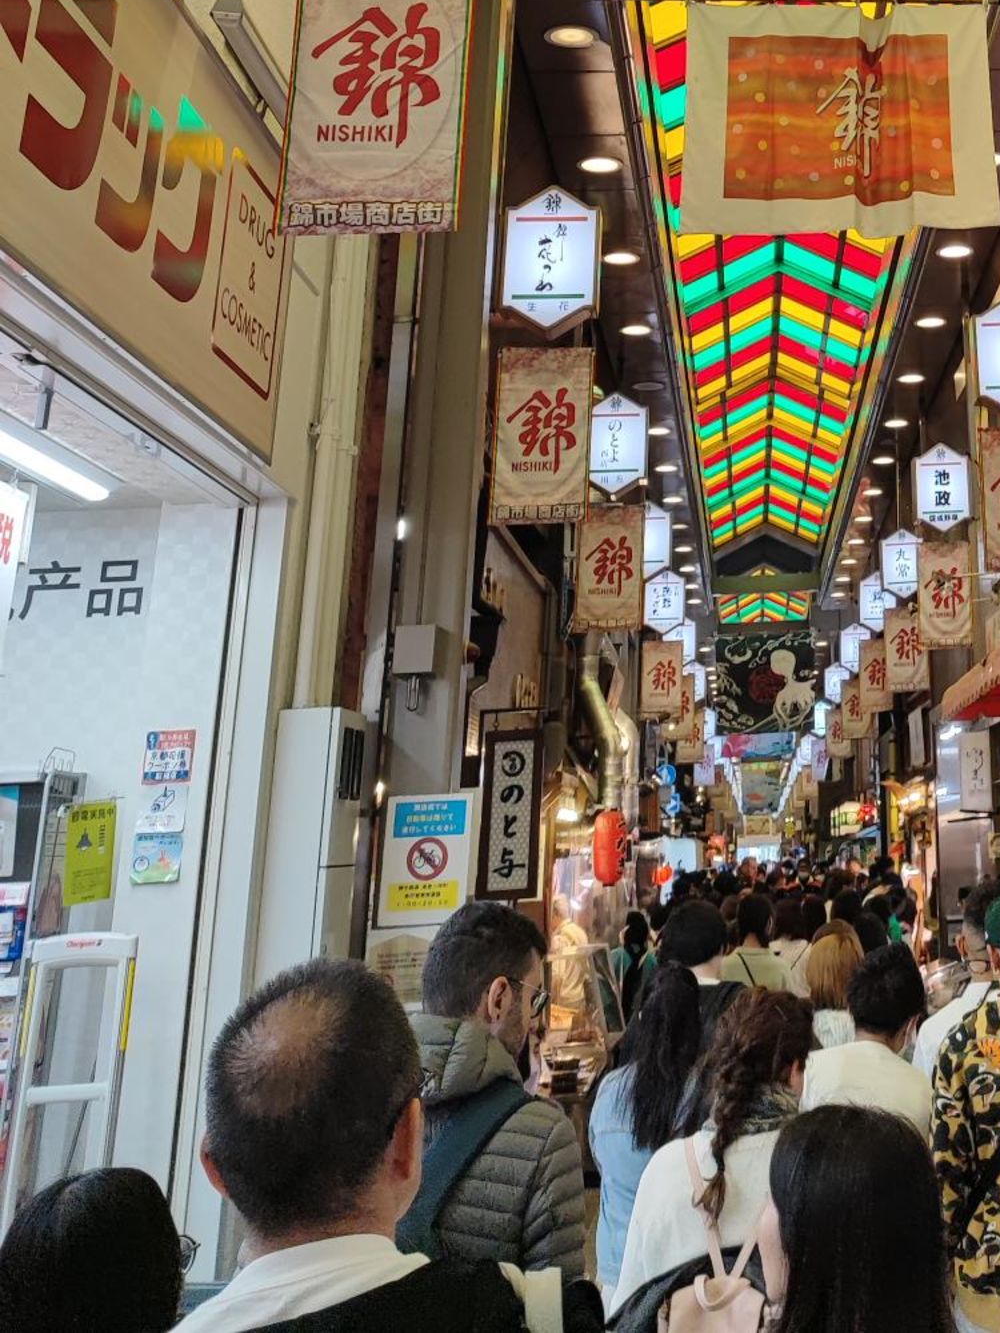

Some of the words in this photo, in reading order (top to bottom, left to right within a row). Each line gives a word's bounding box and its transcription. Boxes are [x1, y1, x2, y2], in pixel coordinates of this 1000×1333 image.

[311, 2, 441, 148] 錦
[317, 124, 393, 142] NISHIKI
[239, 193, 275, 260] DRUG
[289, 200, 444, 227] 錦市場商店街
[248, 261, 256, 295] &
[221, 287, 272, 363] COSMETIC
[506, 387, 577, 475] 錦
[608, 419, 622, 463] のとよ
[511, 461, 553, 472] NISHIKI
[934, 469, 951, 506] 池政
[585, 536, 634, 597] 錦
[890, 626, 922, 667] 錦
[647, 659, 676, 698] 錦
